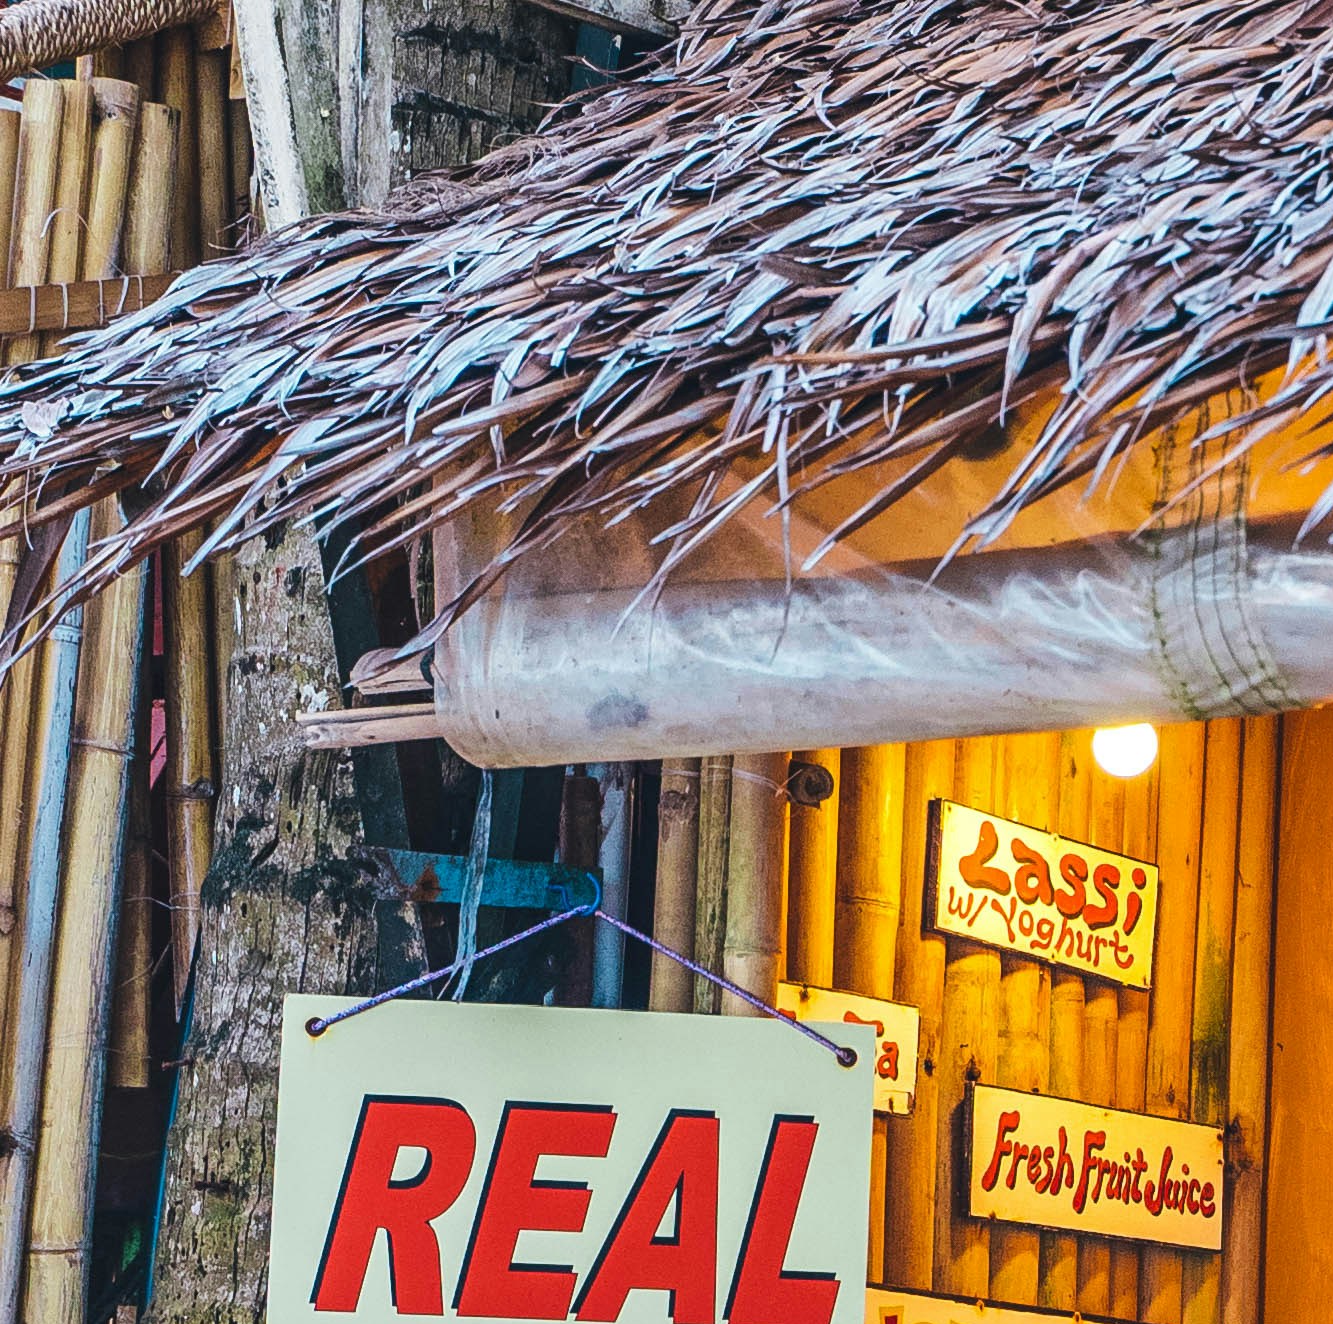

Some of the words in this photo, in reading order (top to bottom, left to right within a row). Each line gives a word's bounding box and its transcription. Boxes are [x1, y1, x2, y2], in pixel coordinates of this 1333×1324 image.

[958, 821, 1147, 936] Lassi
[981, 1110, 1075, 1193] Fresh
[1073, 1130, 1146, 1214] Fruit
[1143, 1145, 1216, 1218] Juice
